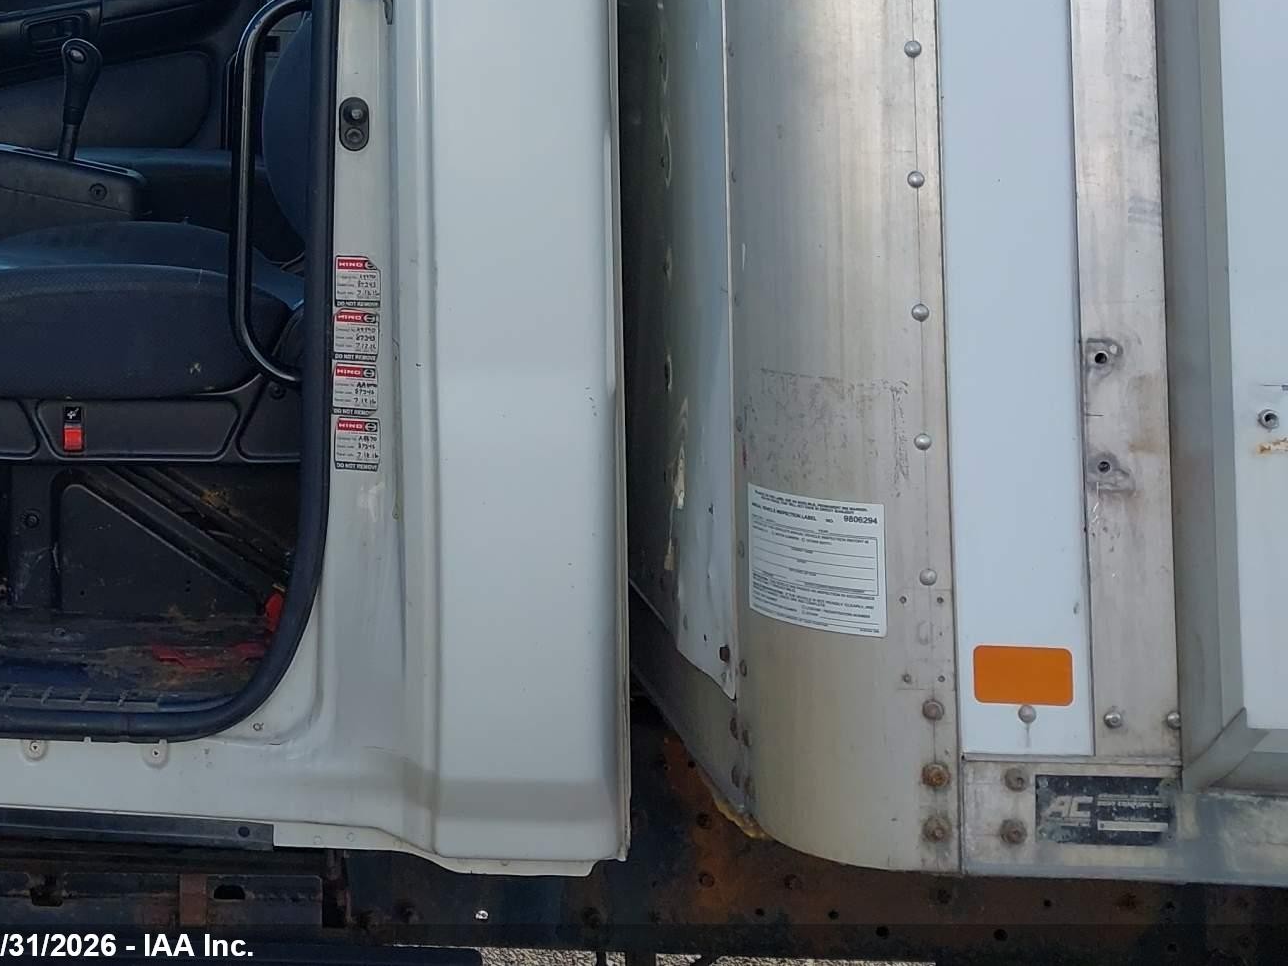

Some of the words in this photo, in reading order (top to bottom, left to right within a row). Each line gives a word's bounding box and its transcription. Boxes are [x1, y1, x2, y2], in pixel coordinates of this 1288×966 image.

[338, 260, 364, 268] HINO
[801, 513, 817, 521] LABEL
[843, 515, 878, 524] 9806294
